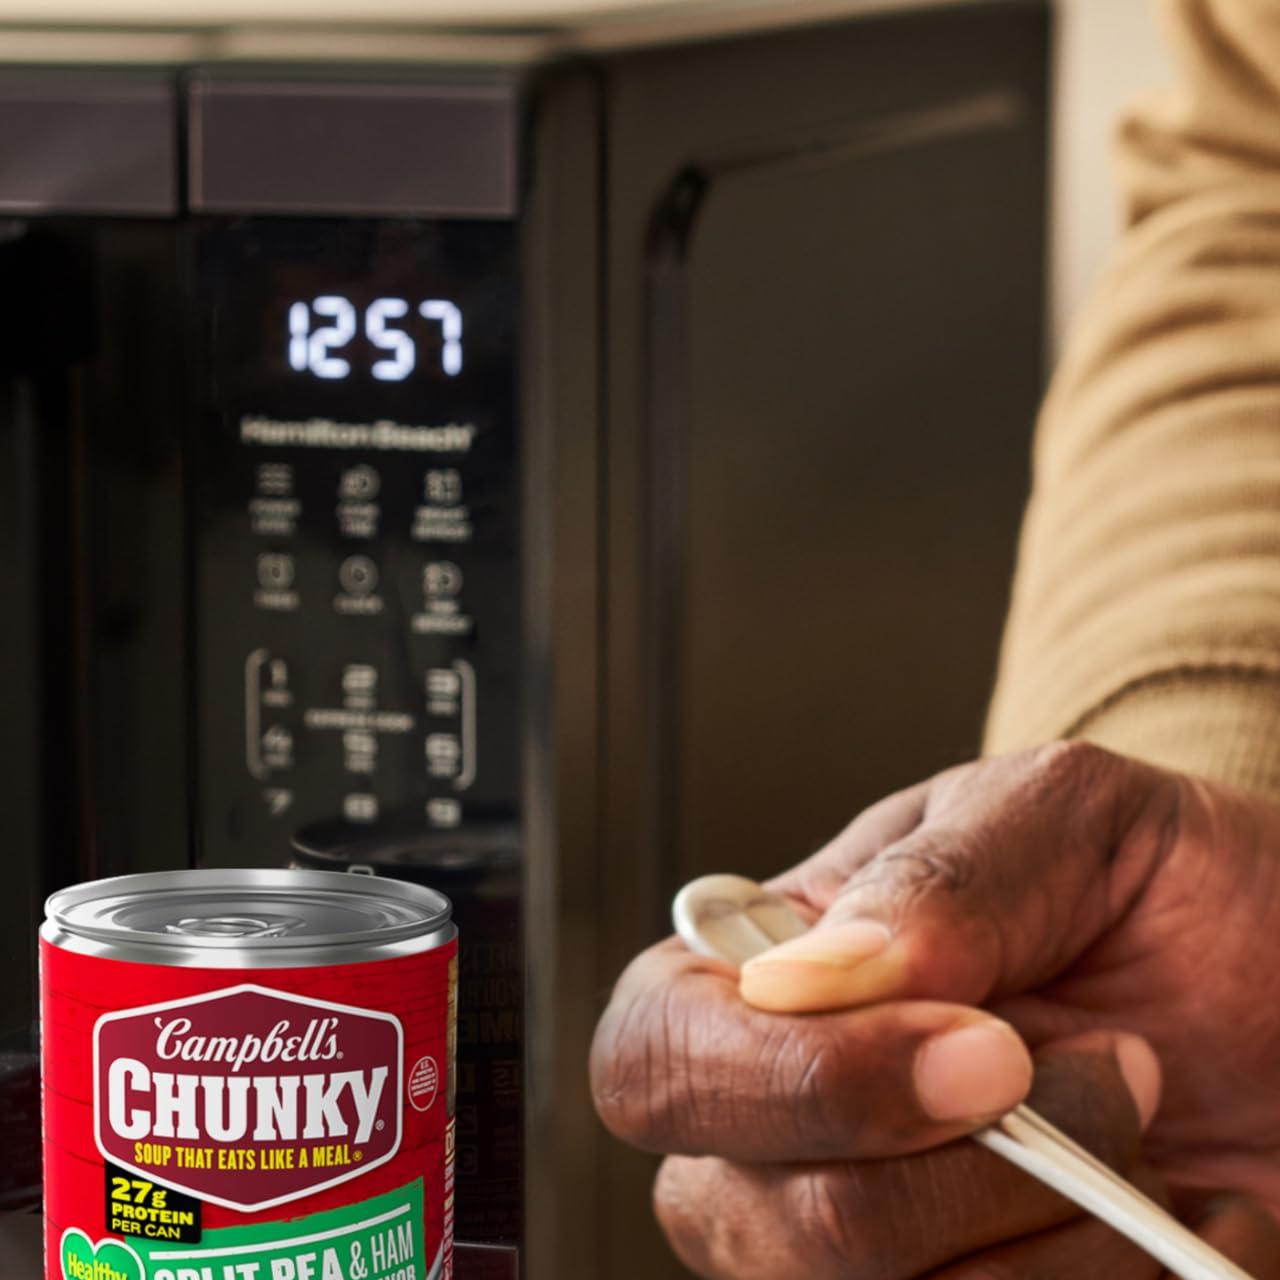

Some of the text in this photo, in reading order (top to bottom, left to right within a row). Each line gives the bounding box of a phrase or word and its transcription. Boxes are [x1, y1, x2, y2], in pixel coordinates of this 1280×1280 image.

[154, 1017, 339, 1072] Campbell's
[108, 1058, 389, 1144] CHUNKY
[134, 1142, 352, 1170] SOUP THAT EATS LIKE A MEAL
[111, 1177, 168, 1208] 27g
[111, 1201, 195, 1226] PROTEIN
[111, 1218, 181, 1239] PER CAN
[348, 1240, 369, 1280] &
[371, 1220, 415, 1275] HAM
